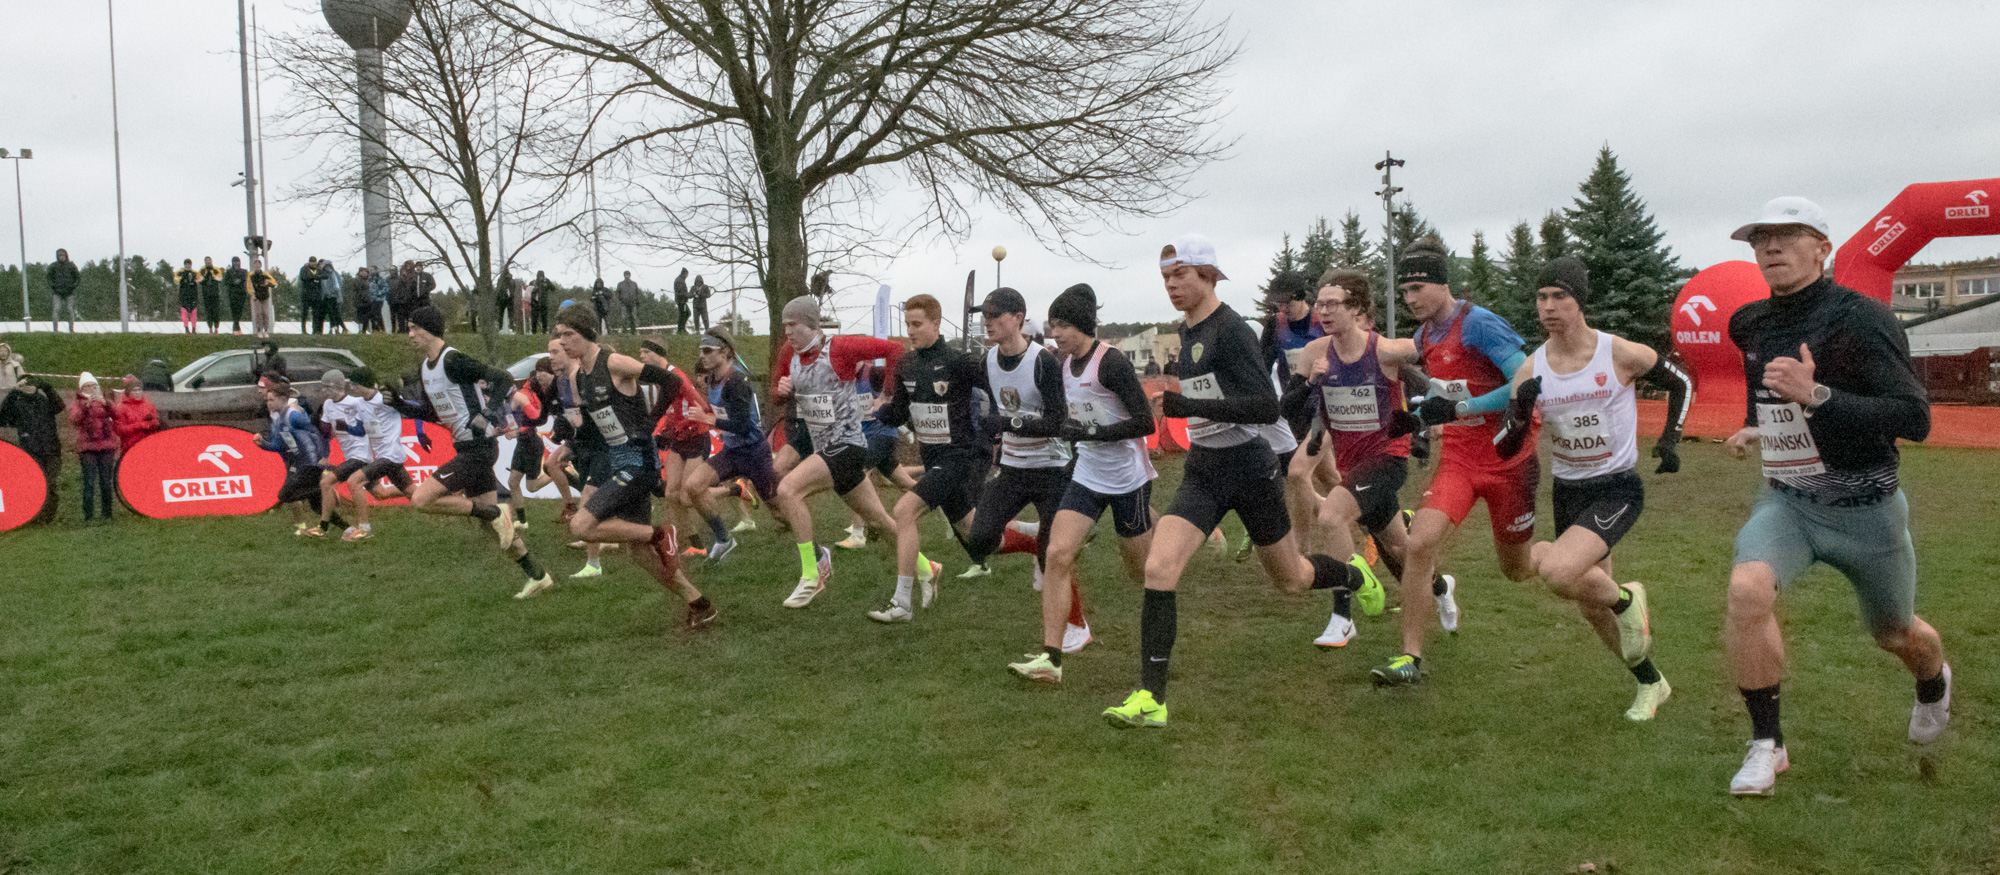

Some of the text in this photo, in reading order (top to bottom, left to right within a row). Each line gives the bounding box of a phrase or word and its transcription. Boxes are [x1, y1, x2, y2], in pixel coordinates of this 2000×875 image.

[1948, 208, 1986, 218] ORLEN
[1871, 224, 1903, 253] ORLEN
[1676, 331, 1721, 344] ORLEN
[1192, 378, 1211, 392] 473
[1446, 383, 1463, 393] 128
[1350, 388, 1370, 398] 462
[812, 396, 829, 404] 478
[596, 409, 611, 420] 424
[927, 405, 944, 414] 130
[1327, 404, 1376, 415] SOKOŁOWSKI
[1771, 408, 1794, 423] 110
[1573, 414, 1600, 428] 385
[1551, 434, 1606, 451] PORADA
[168, 479, 246, 498] ORLEN
